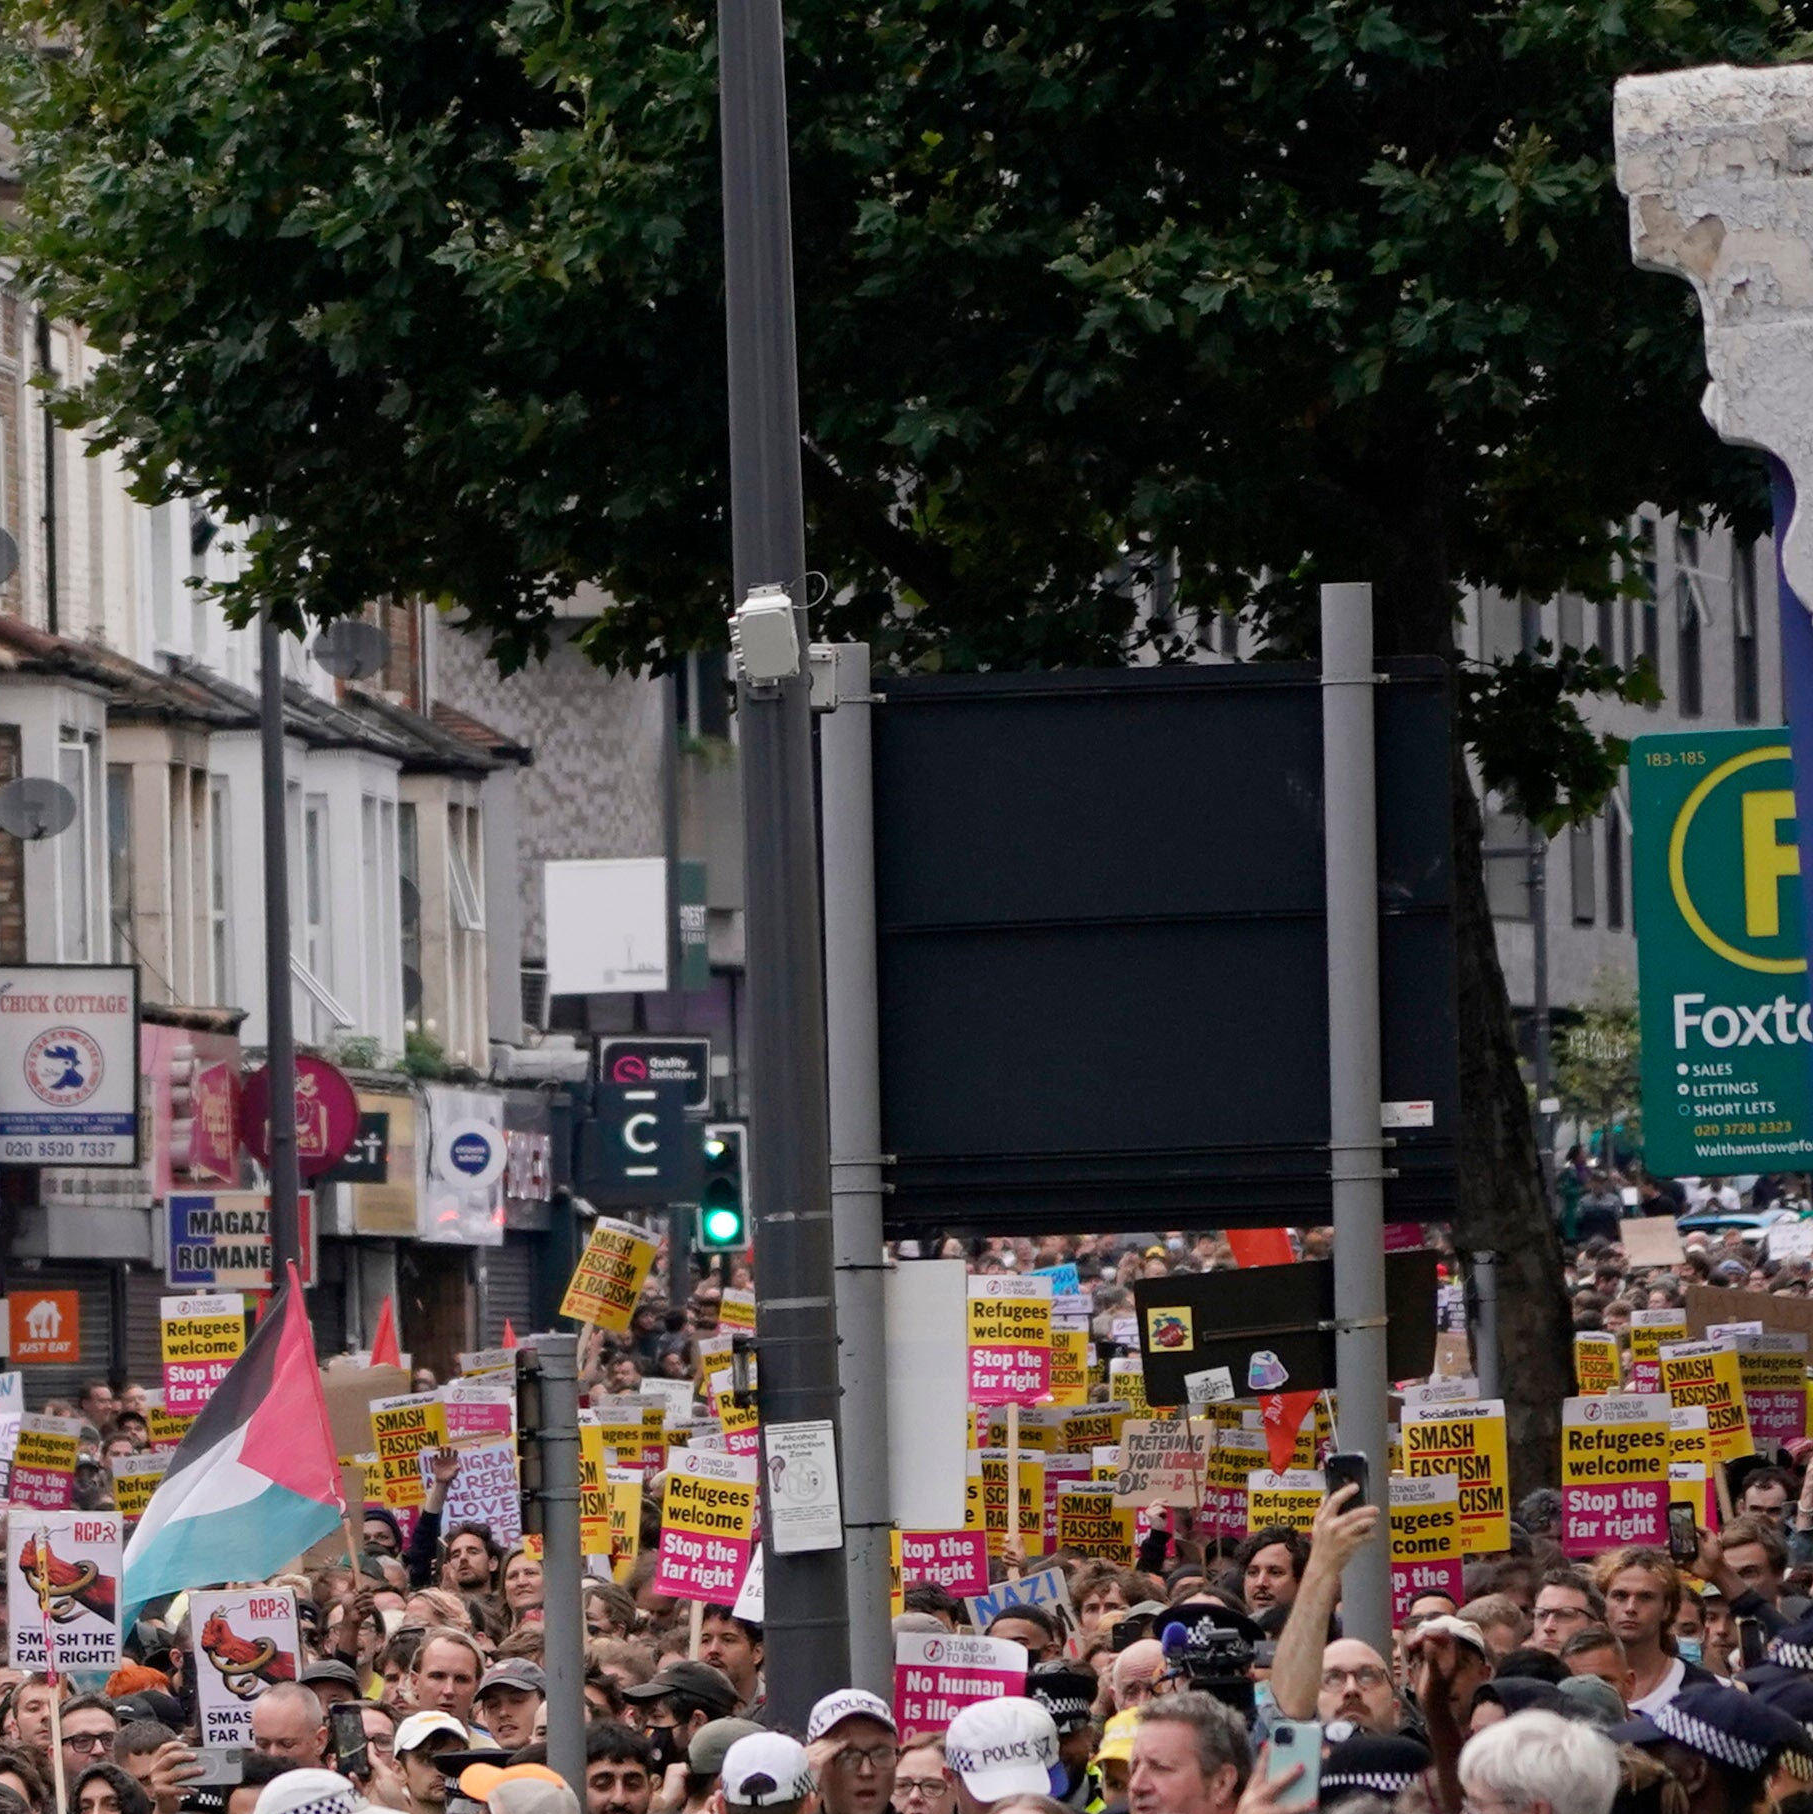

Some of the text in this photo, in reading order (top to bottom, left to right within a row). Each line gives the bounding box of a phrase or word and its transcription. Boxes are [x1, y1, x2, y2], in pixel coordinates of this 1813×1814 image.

[1645, 751, 1706, 766] 183-185
[0, 995, 128, 1014] CHICK COTTAGE
[649, 1056, 689, 1070] Quality
[1692, 1063, 1733, 1077] SALES
[649, 1068, 697, 1081] Solicitors
[1692, 1082, 1759, 1097] LETTINGS
[1694, 1101, 1776, 1117] SHORT LETS
[1695, 1124, 1720, 1136] 020
[5, 1142, 116, 1157] 020 8520 7337
[593, 1231, 634, 1257] SMASH
[177, 1244, 273, 1271] ROMANE
[582, 1252, 636, 1284] FASCISM
[973, 1302, 1048, 1320] Refugees
[167, 1321, 241, 1339] Refugees
[974, 1322, 1045, 1340] welcome
[18, 1341, 71, 1356] JUST EAT
[168, 1340, 238, 1355] welcome
[973, 1350, 1042, 1370] Stop the
[1666, 1358, 1714, 1382] SMASH
[973, 1369, 1041, 1392] far right
[376, 1409, 426, 1433] SMASH
[1149, 1421, 1181, 1434] STOP
[379, 1430, 439, 1456] FASCISM
[774, 1441, 826, 1450] Restriction
[782, 1432, 818, 1441] Alcohol
[1129, 1435, 1205, 1451] PRETENDING
[1409, 1423, 1474, 1451] SMASH
[1569, 1429, 1665, 1454] Refugees
[1128, 1453, 1163, 1470] YOUR
[1569, 1455, 1660, 1476] welcome
[670, 1478, 750, 1507] Refugees
[1568, 1487, 1657, 1515] Stop the
[449, 1496, 514, 1518] LOVE
[1062, 1495, 1112, 1515] SMASH
[669, 1505, 744, 1530] welcome
[1568, 1513, 1656, 1540] far right
[75, 1522, 102, 1541] RCP
[1062, 1520, 1123, 1538] FASCISM
[664, 1535, 738, 1563] Stop the
[662, 1559, 735, 1589] far right
[1412, 1566, 1449, 1588] the
[250, 1599, 276, 1618] RCP
[974, 1572, 1058, 1626] NAZI
[906, 1671, 1005, 1696] No human
[830, 1700, 873, 1715] POLICE
[982, 1740, 1030, 1764] POLICE
